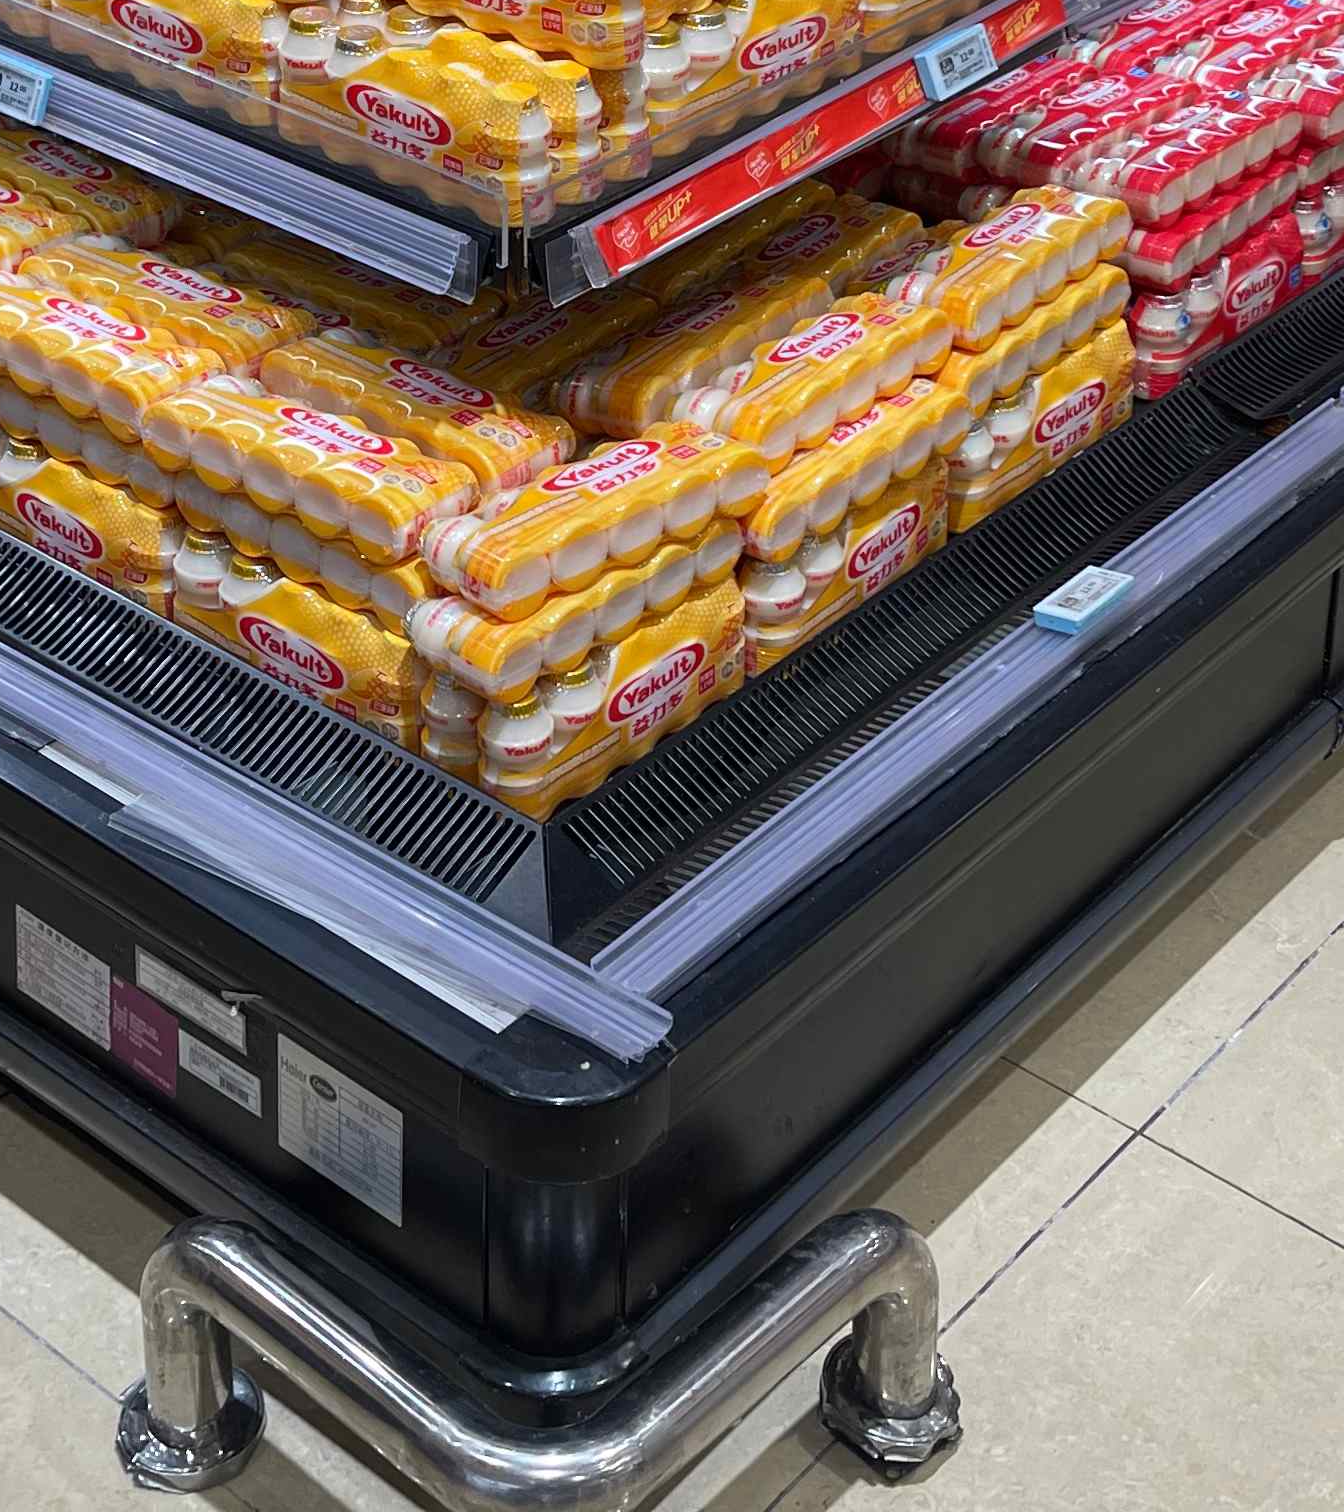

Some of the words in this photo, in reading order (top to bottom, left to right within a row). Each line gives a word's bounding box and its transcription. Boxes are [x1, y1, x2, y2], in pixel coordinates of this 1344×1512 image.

[122, 6, 191, 43] Yakult
[754, 22, 819, 62] Yakult
[354, 89, 437, 135] Yakult
[42, 144, 100, 178] Yakult
[369, 129, 427, 161] 益力多
[975, 205, 1035, 246] Yakult
[153, 264, 231, 302] Yakult
[1228, 265, 1283, 309] Yakult
[60, 300, 136, 339] Yakult
[783, 314, 851, 359] Yakult
[403, 363, 483, 406] Yakult
[294, 409, 384, 453] Yakult
[1043, 388, 1099, 436] Yakult
[280, 423, 343, 455] 益力多
[1050, 424, 1090, 456] 益力多
[558, 444, 647, 487] Yakult
[30, 499, 95, 552] Yakult
[859, 517, 914, 567] Yakult
[253, 624, 330, 679] Yakult
[622, 653, 694, 716] Yakult
[632, 691, 688, 737] 益力多
[504, 737, 553, 758] Yakult
